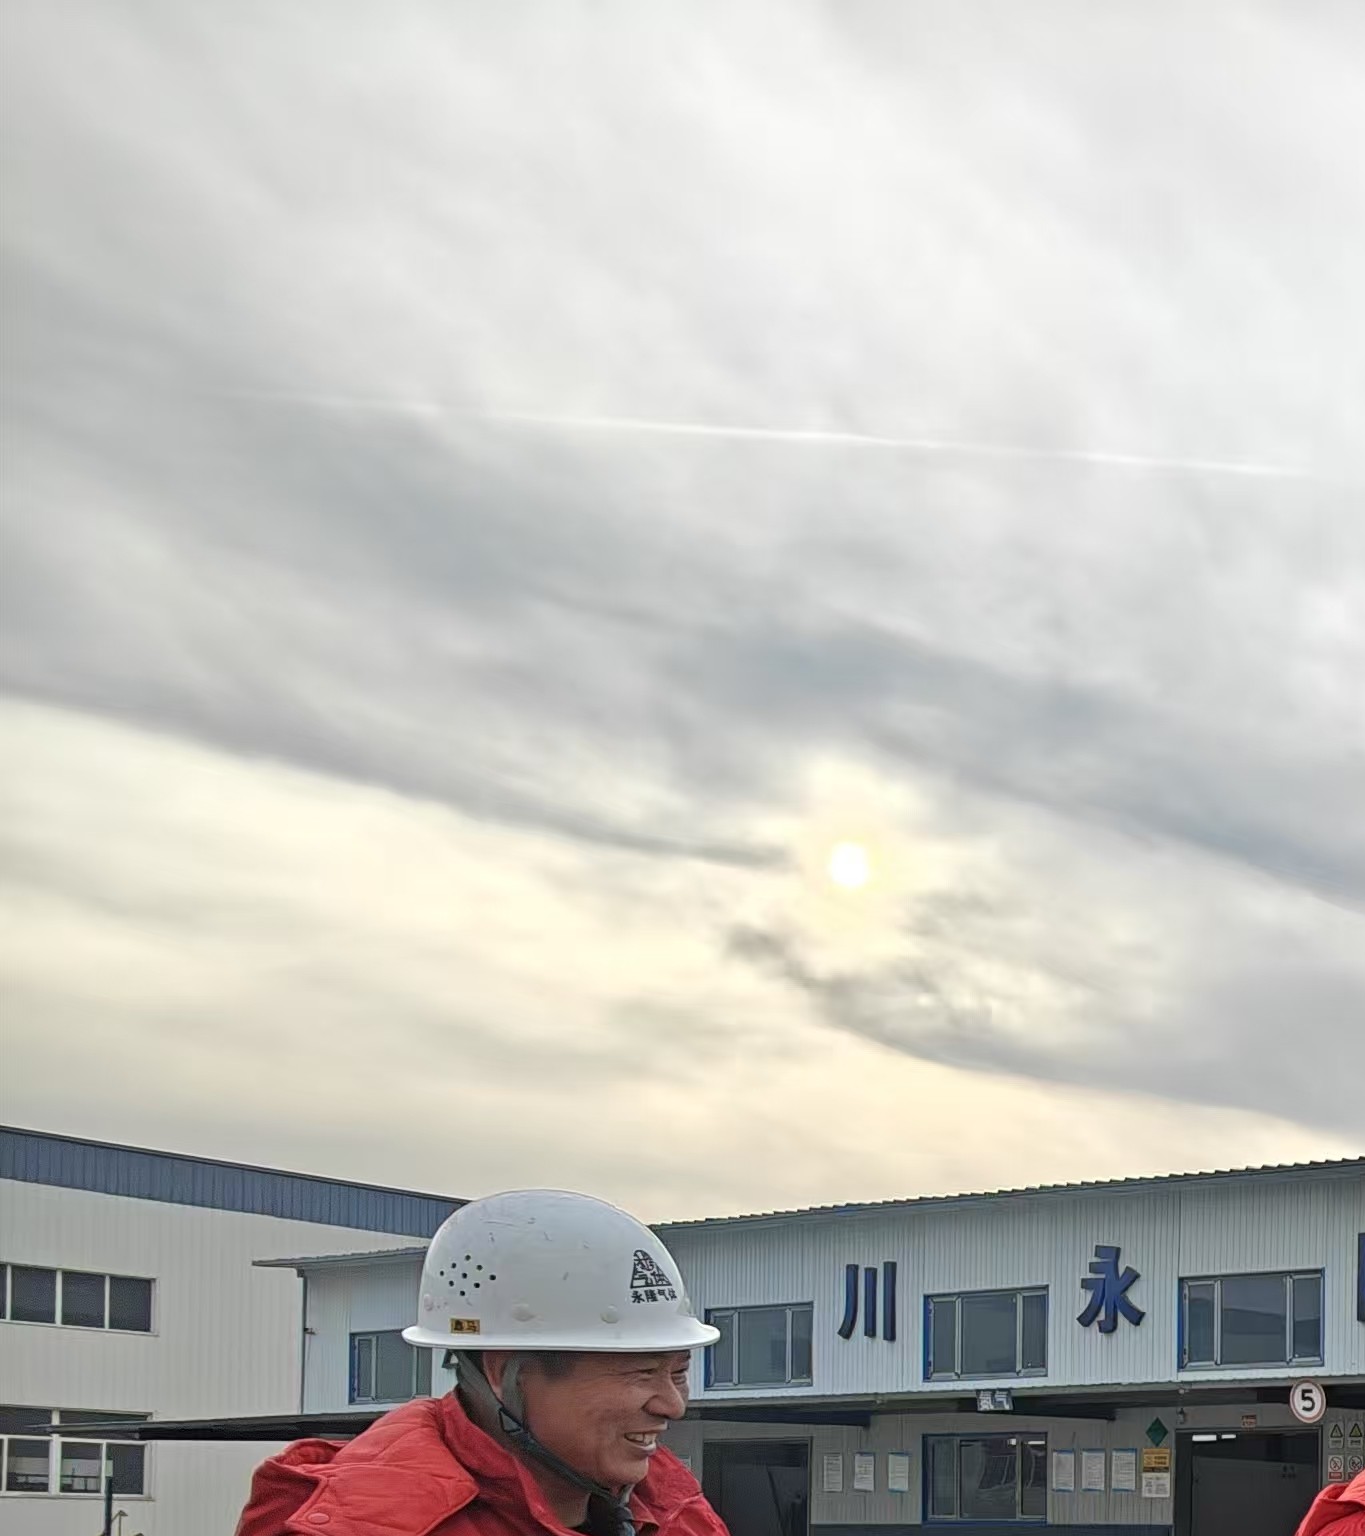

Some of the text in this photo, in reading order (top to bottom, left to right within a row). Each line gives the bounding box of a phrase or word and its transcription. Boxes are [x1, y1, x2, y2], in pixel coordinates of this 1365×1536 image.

[631, 1288, 677, 1304] 永隆气体
[1301, 1388, 1315, 1412] 5
